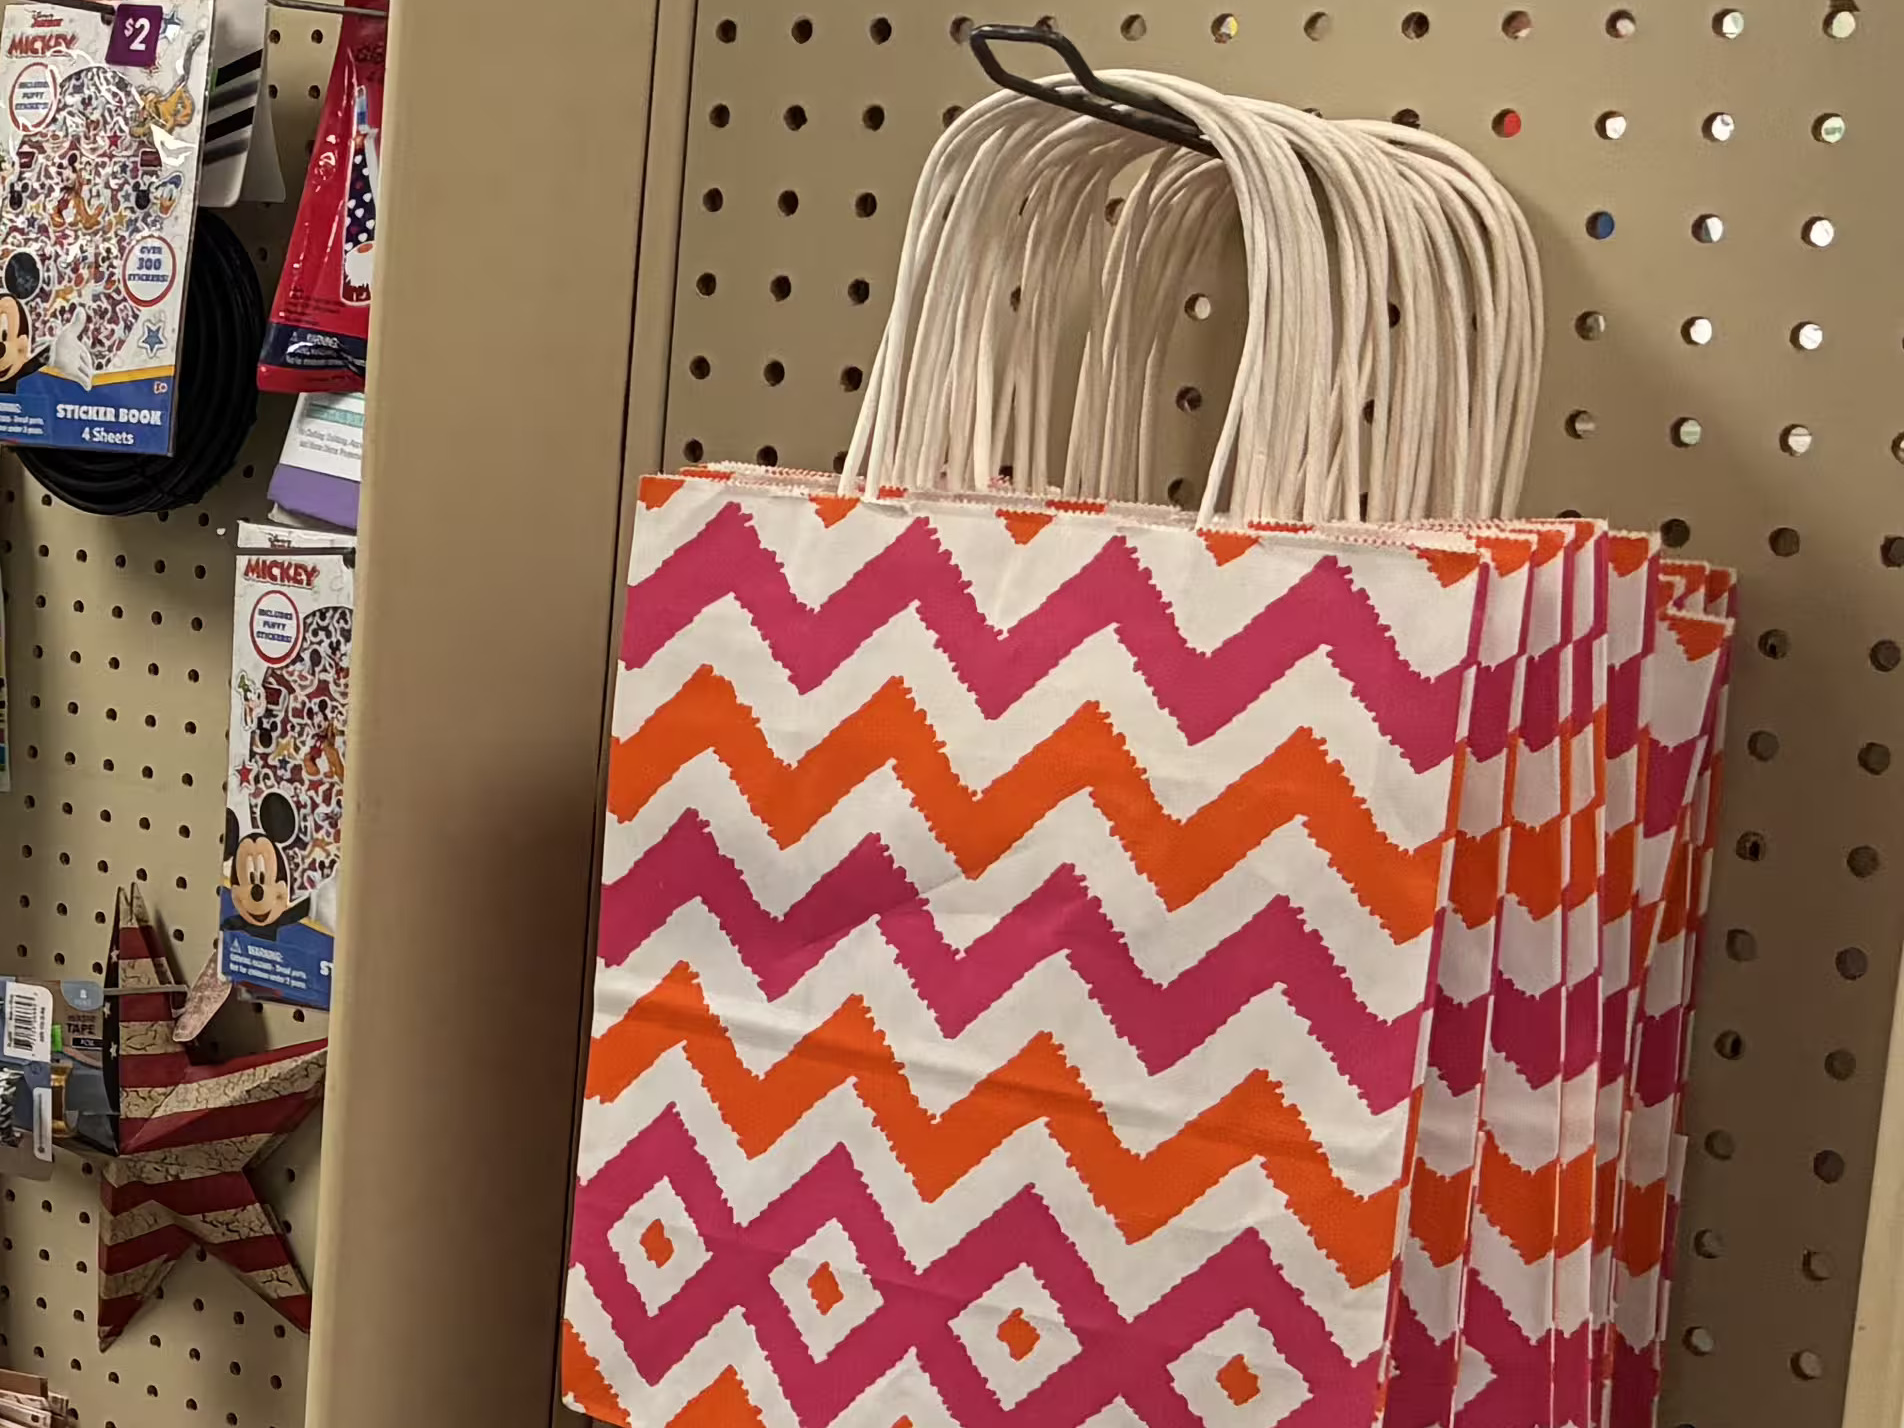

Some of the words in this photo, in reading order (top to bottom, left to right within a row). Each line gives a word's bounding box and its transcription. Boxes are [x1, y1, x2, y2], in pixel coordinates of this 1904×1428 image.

[123, 16, 152, 52] $2
[7, 33, 76, 59] MICKEY
[135, 255, 164, 272] 300
[55, 403, 117, 424] STICKER
[118, 408, 162, 426] BOOK
[81, 427, 90, 443] 4
[91, 426, 135, 446] Sheets
[244, 556, 321, 588] MICKEY
[66, 1022, 96, 1036] TAPE
